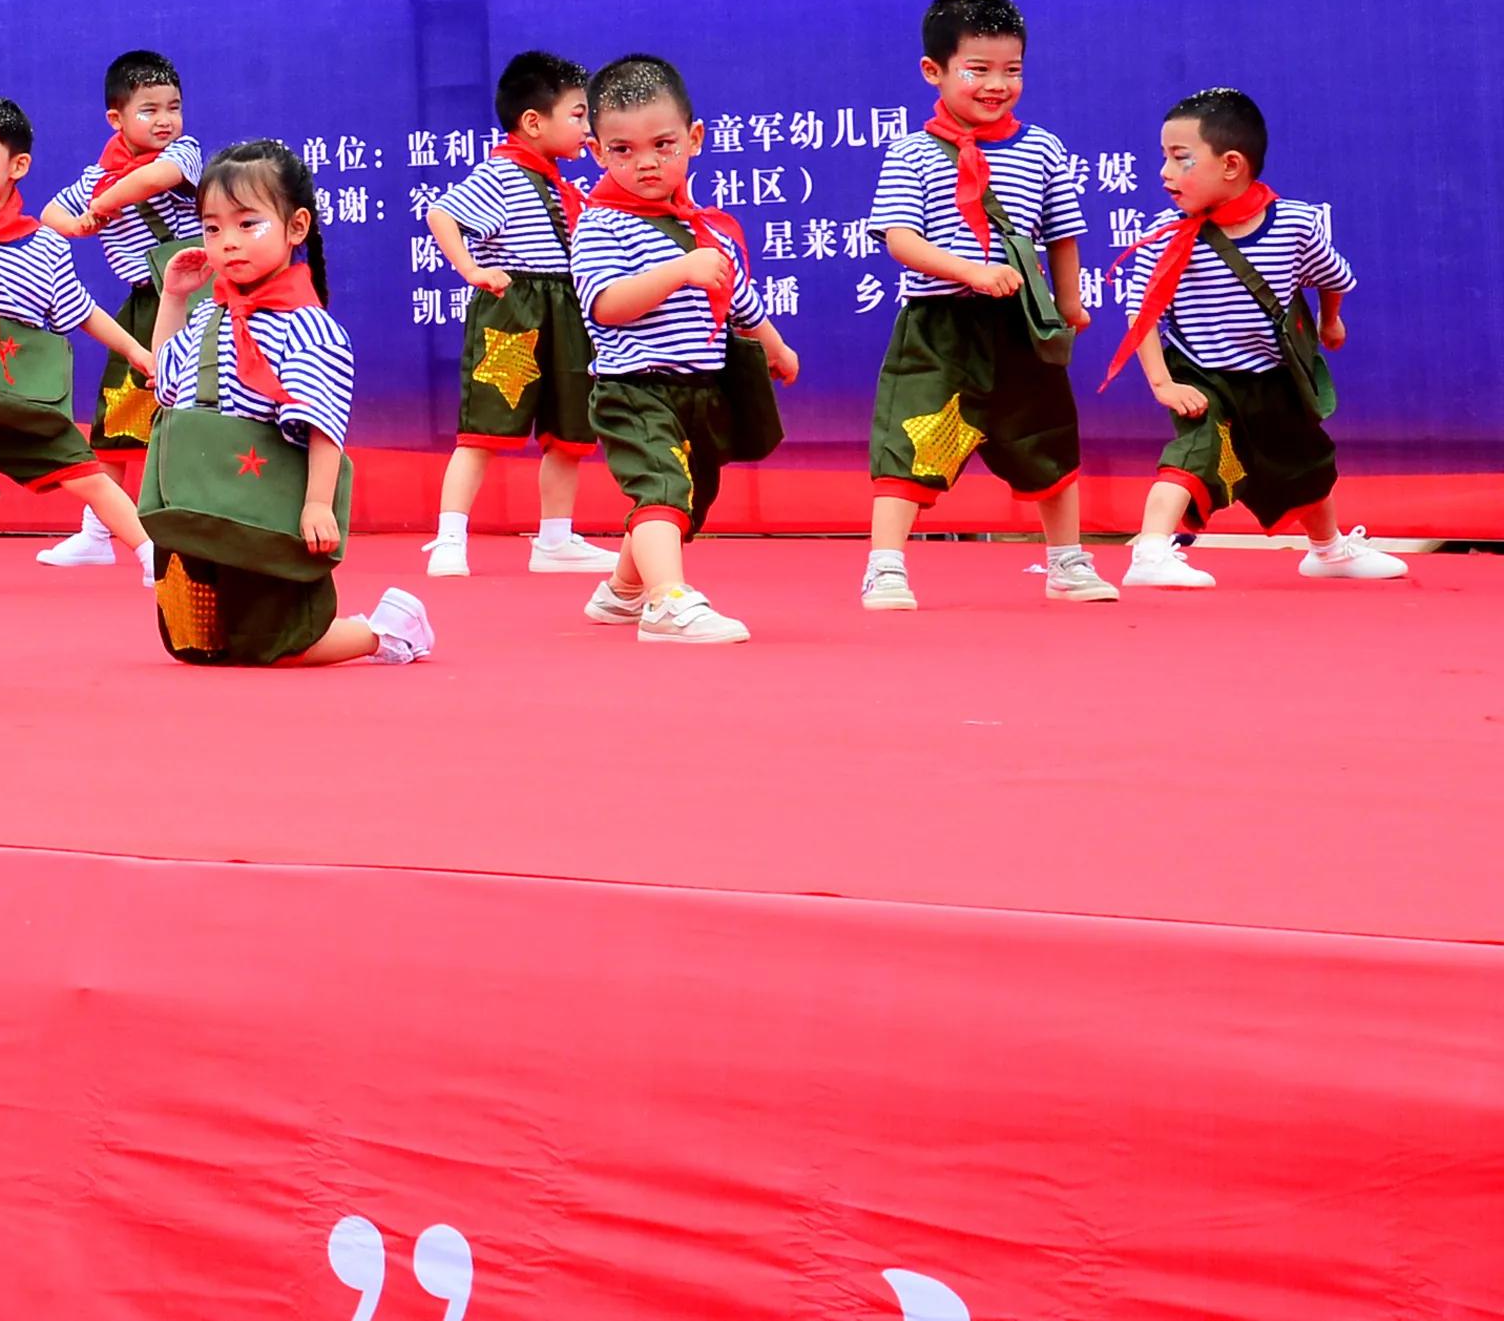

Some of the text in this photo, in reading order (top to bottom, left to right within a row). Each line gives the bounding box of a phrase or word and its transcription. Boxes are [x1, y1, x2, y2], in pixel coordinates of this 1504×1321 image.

[694, 106, 909, 156] 童军幼儿园
